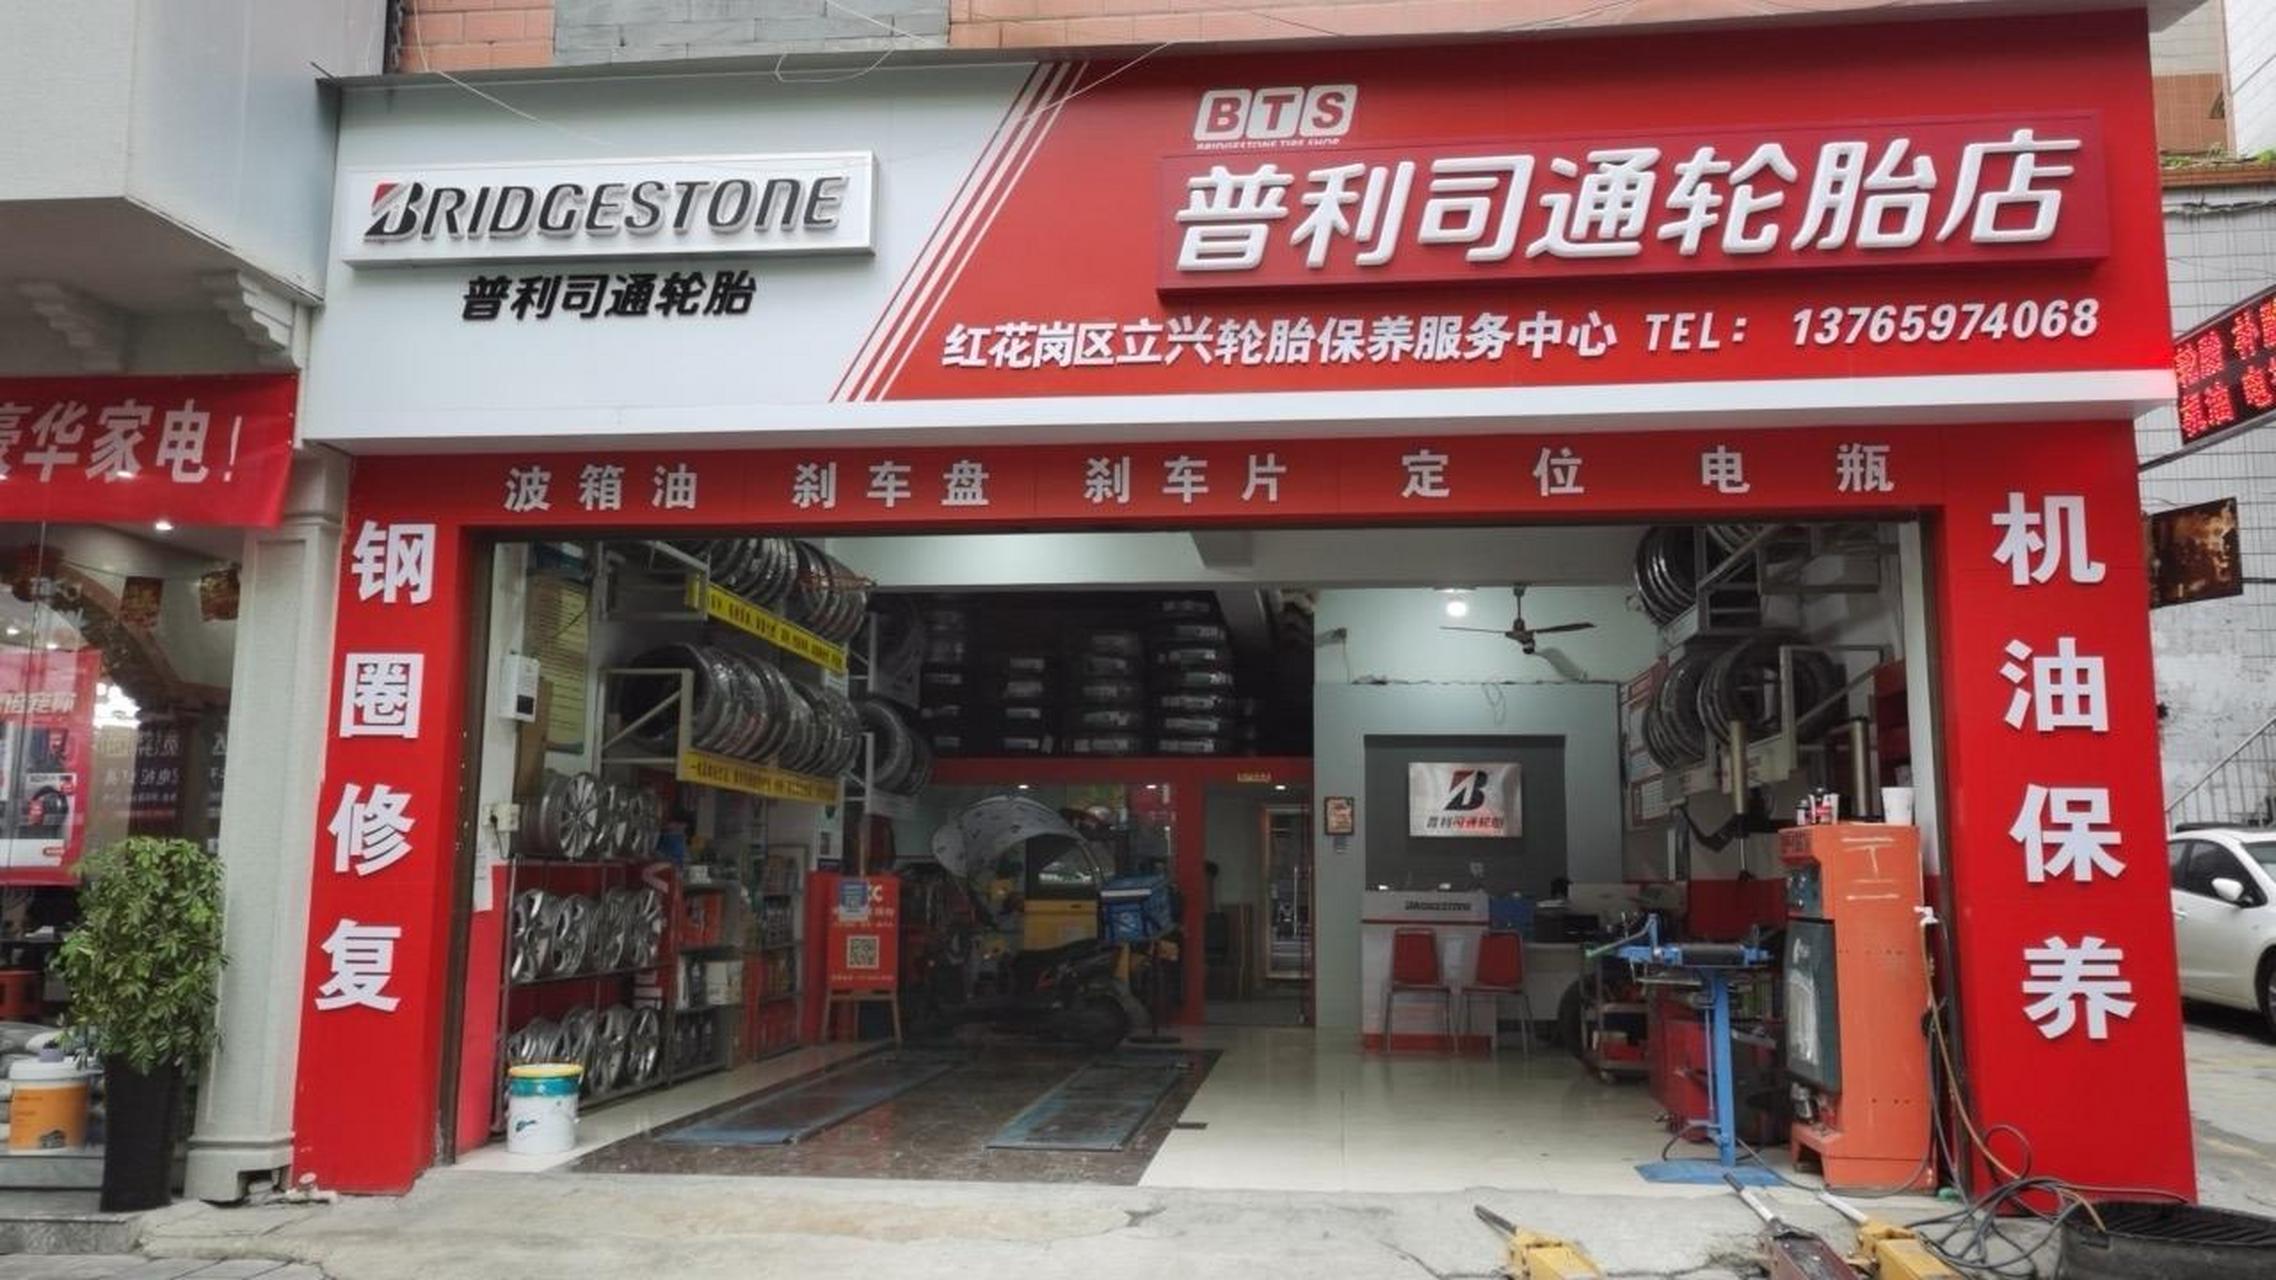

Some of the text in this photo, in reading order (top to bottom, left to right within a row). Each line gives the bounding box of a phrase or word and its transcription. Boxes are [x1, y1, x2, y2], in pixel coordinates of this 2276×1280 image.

[1205, 91, 1347, 133] BTS
[363, 176, 850, 243] BRIDGESTONE
[1175, 128, 2083, 272] 普利司通轮胎店
[461, 269, 758, 322] 普利司通轮胎
[940, 310, 1618, 368] 红花岗区立兴轮胎保养服务中心
[1792, 298, 2100, 346] 13765974068
[503, 463, 698, 513] 波箱油
[792, 460, 990, 509] 刹车盘
[1084, 453, 1288, 505] 刹车片
[314, 518, 437, 1013] 钢圈修复
[1991, 490, 2138, 1042] 机油保养
